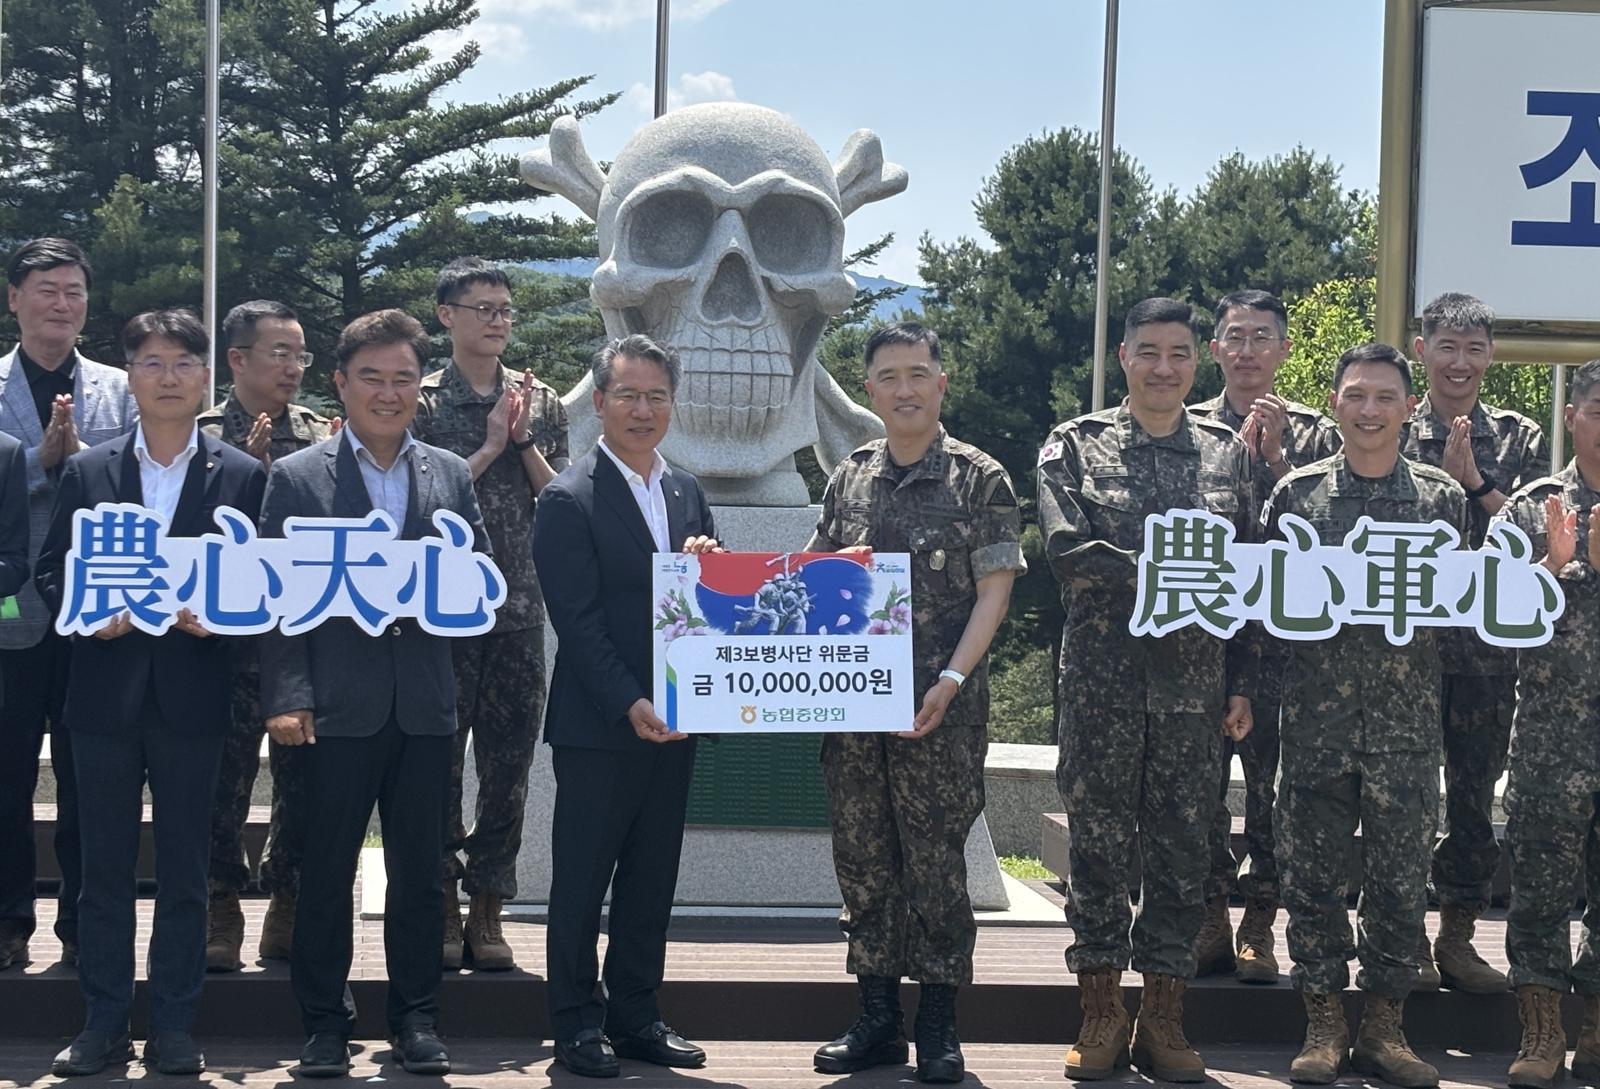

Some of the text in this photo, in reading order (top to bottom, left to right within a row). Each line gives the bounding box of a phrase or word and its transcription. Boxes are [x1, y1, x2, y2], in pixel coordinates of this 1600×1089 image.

[63, 511, 501, 629] 農心天心
[1136, 514, 1558, 639] 農心軍心
[715, 645, 870, 663] 제3보병사단 위문금
[692, 669, 893, 697] 금 10,000,000원
[762, 707, 845, 723] 농협중앙회
